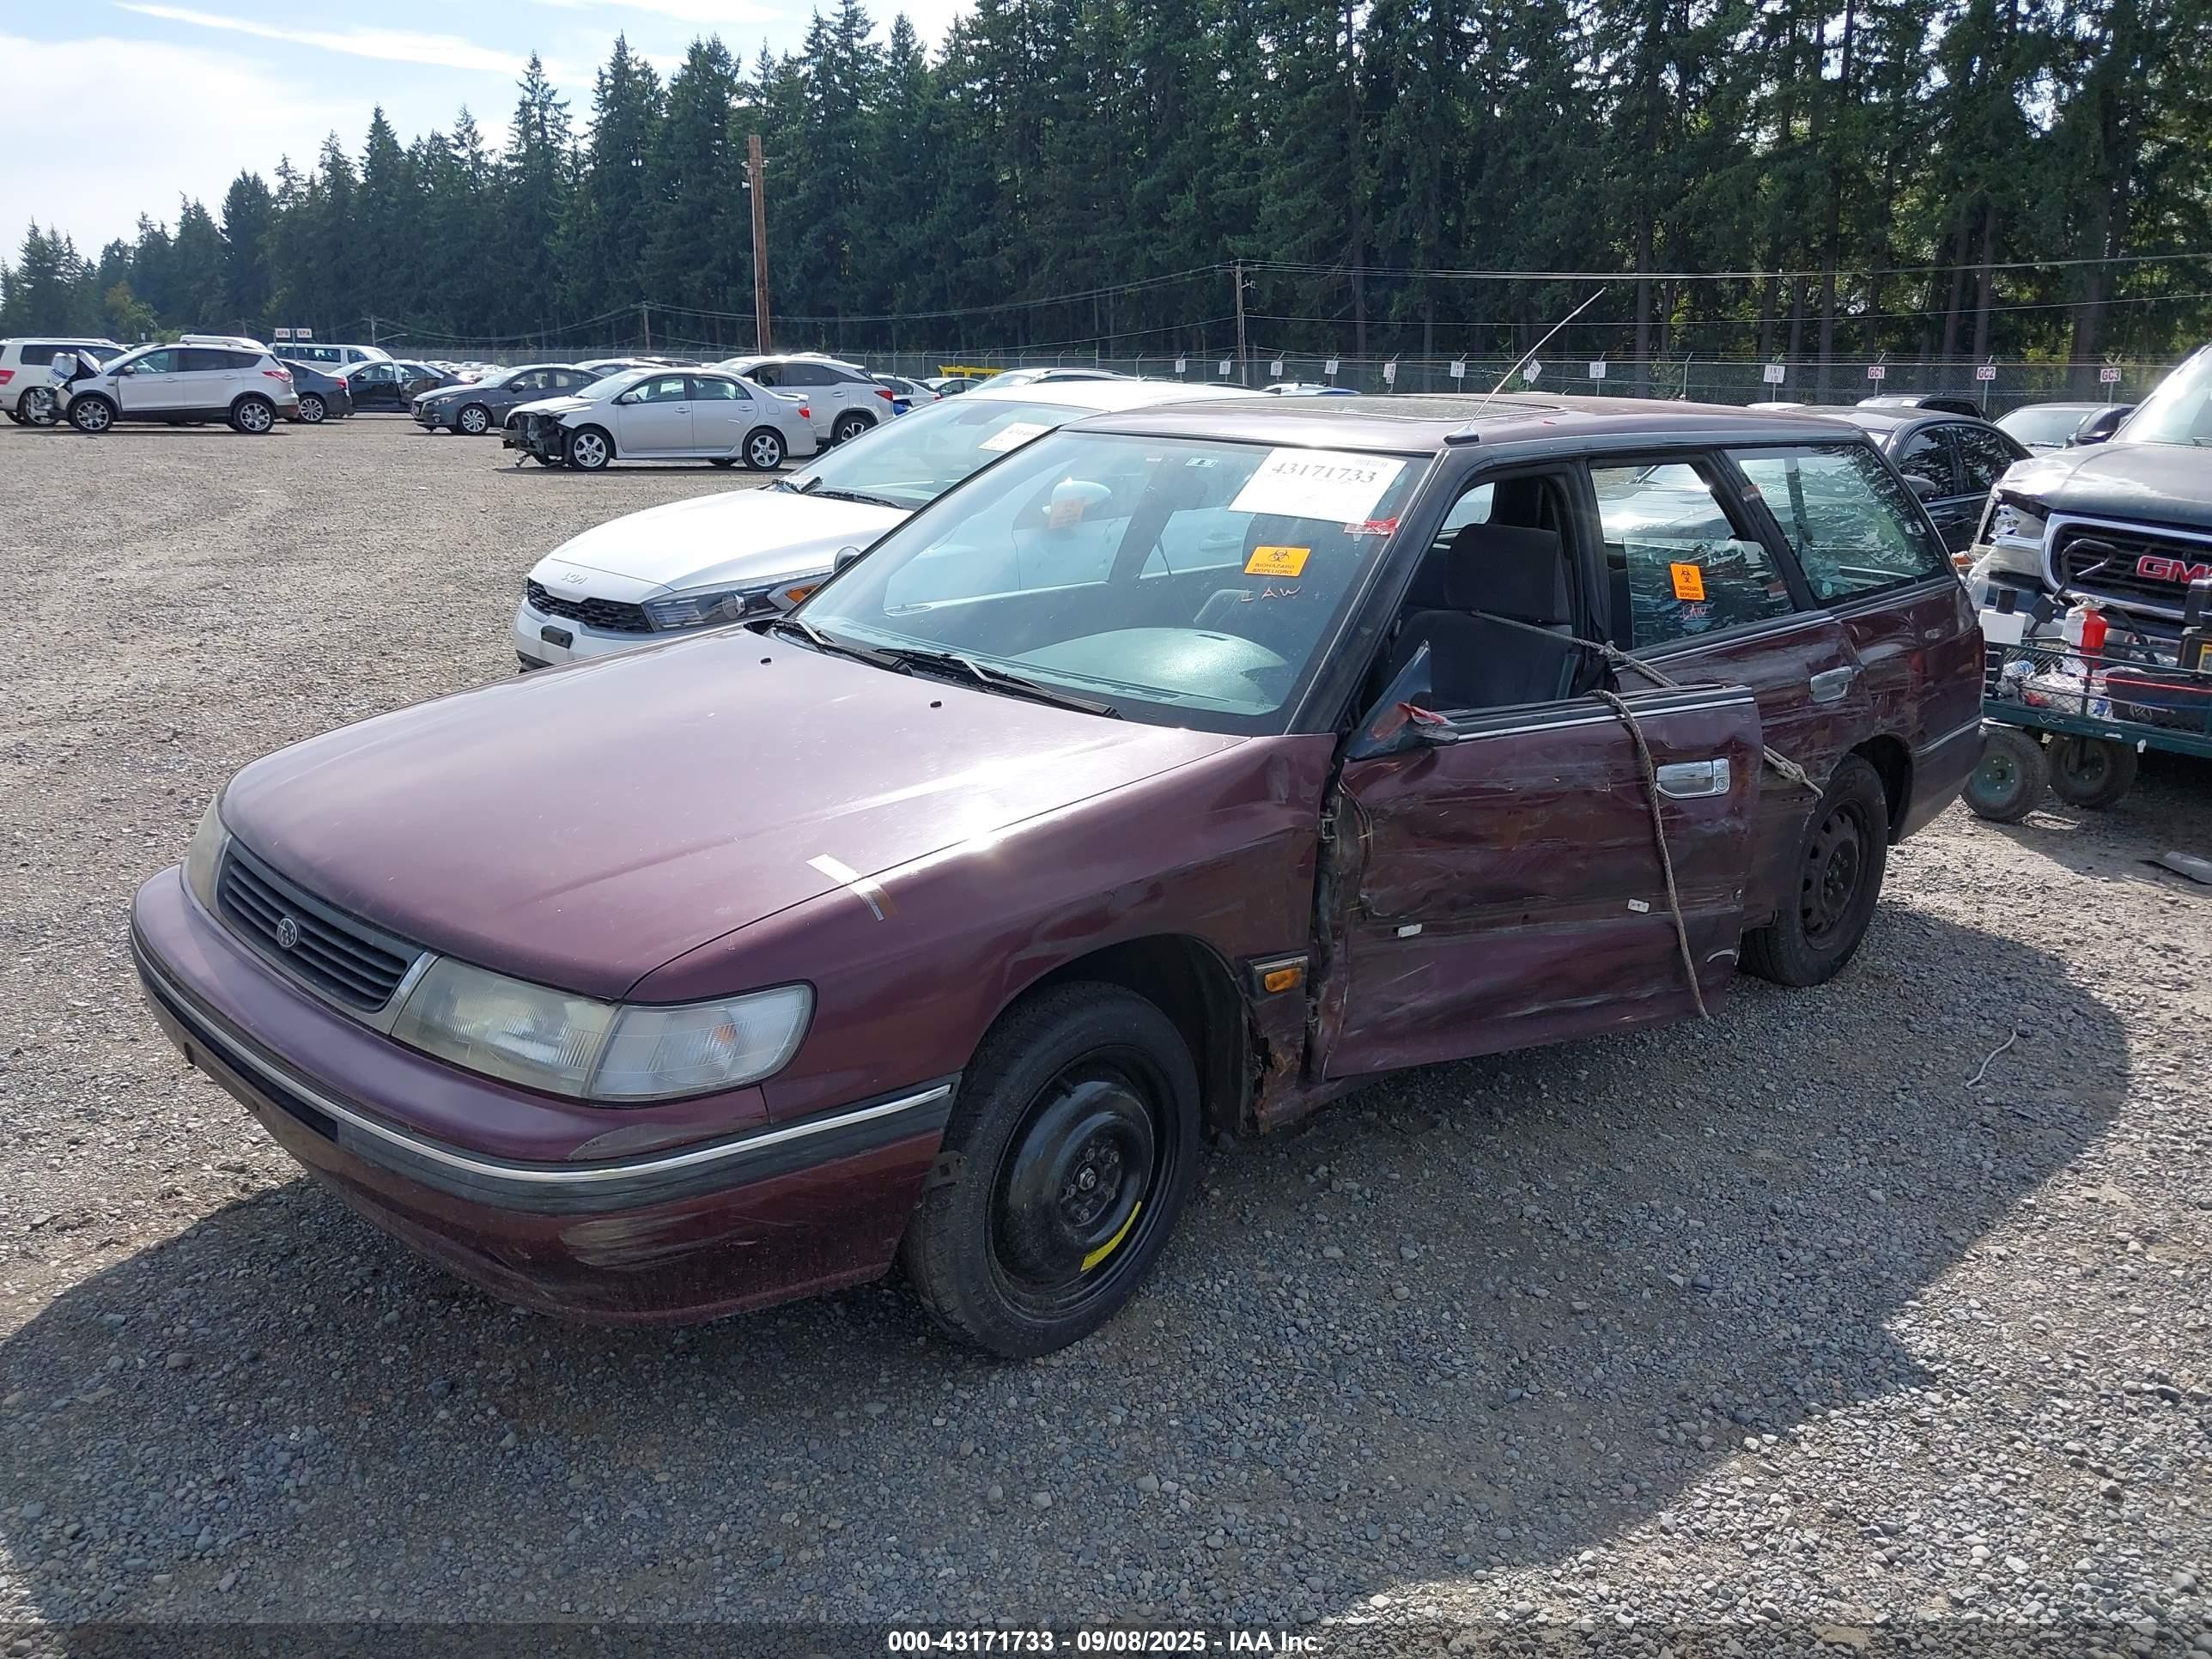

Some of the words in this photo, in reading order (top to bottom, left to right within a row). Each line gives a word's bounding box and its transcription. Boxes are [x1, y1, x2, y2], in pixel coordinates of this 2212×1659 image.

[1869, 368, 1883, 378] GC1
[1978, 368, 1995, 379] GC2
[2102, 370, 2119, 380] GC3
[1272, 462, 1377, 483] 43171733
